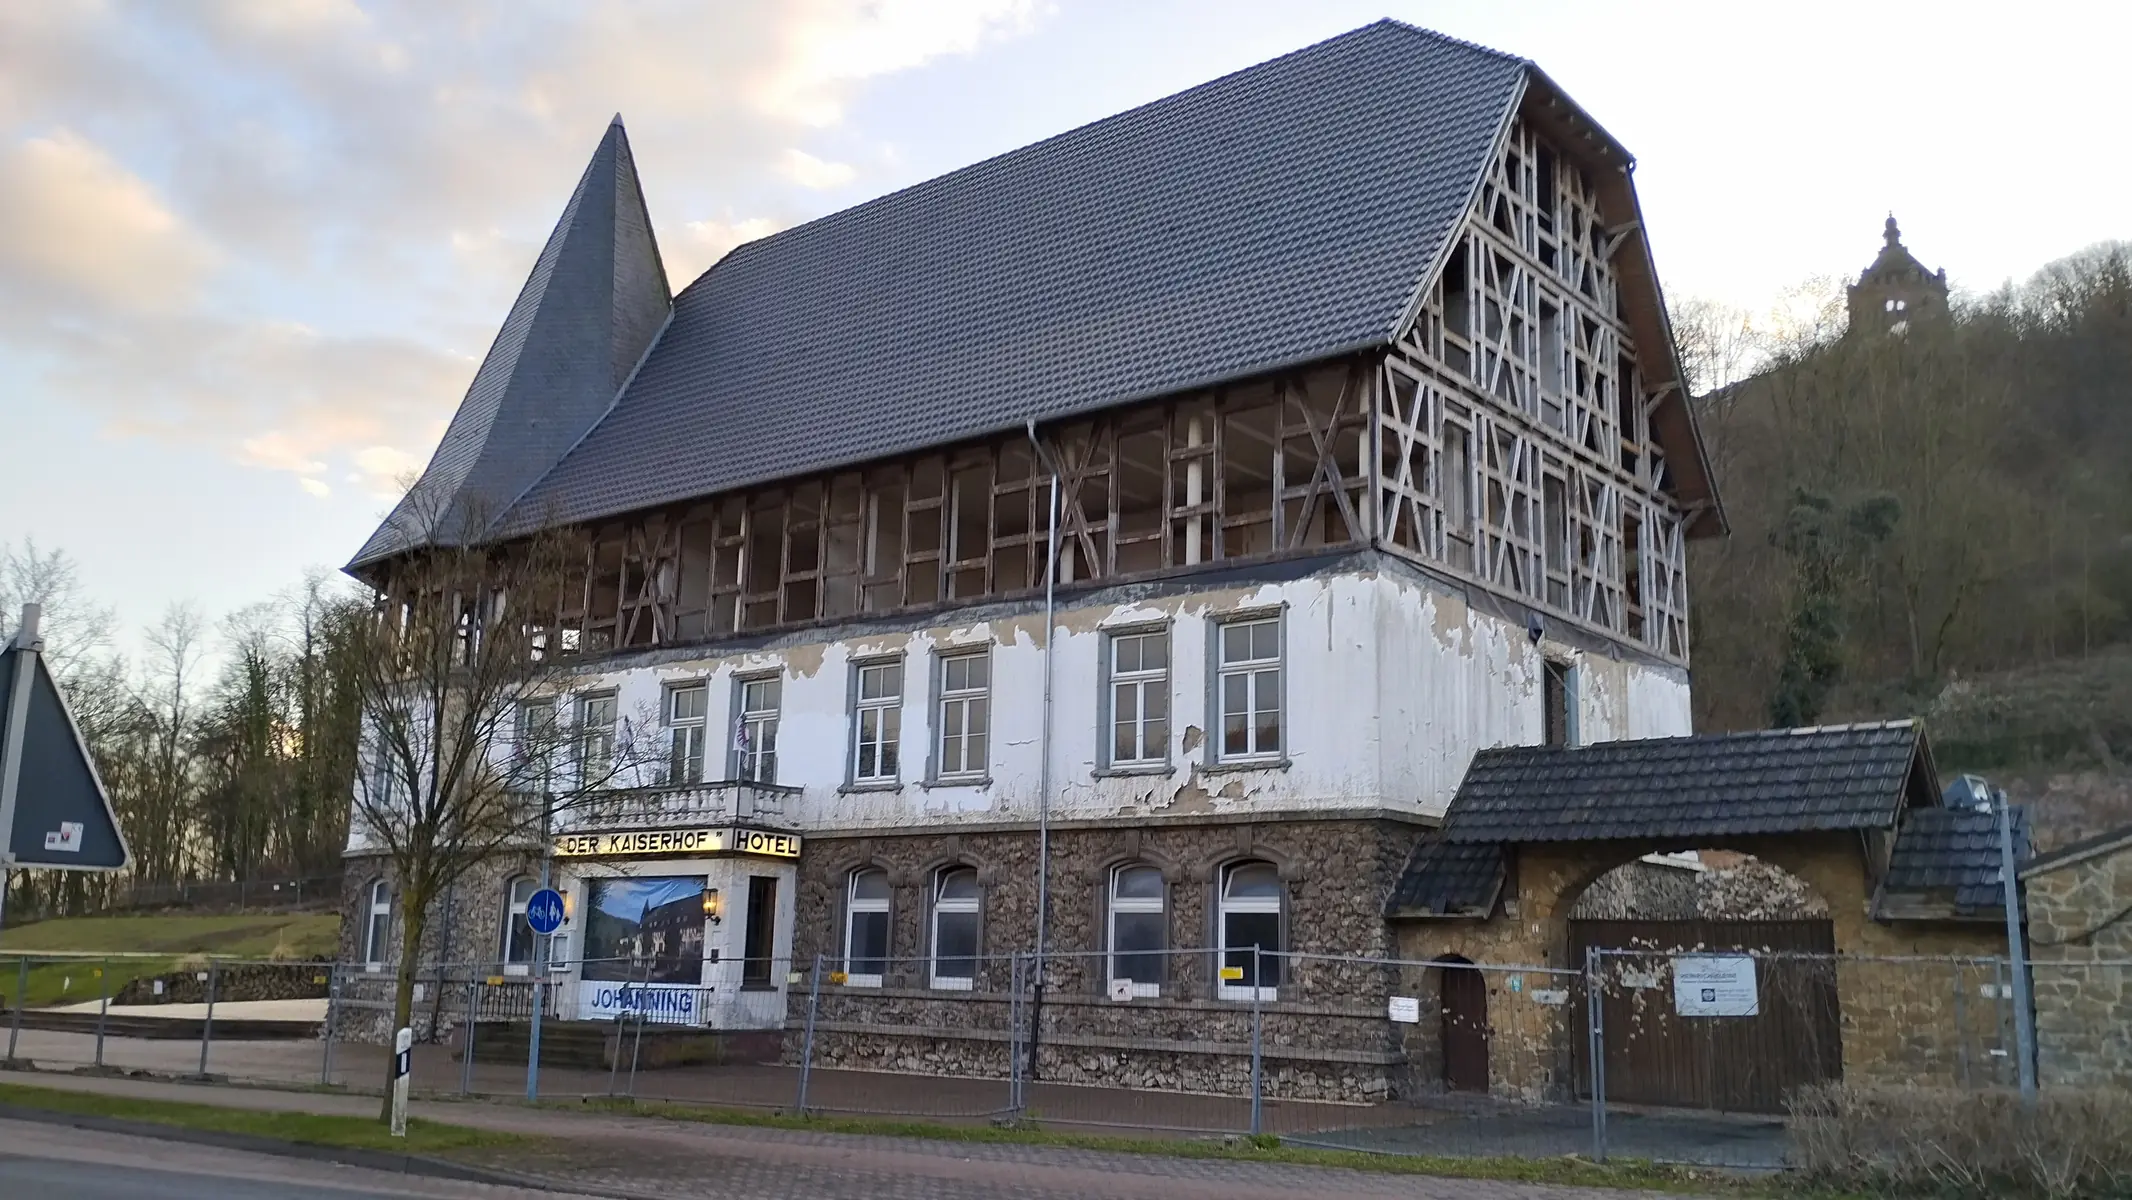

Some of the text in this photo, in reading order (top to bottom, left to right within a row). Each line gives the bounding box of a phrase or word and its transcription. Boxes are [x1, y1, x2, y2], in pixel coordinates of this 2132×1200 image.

[566, 837, 599, 853] DER
[609, 831, 708, 852] KAISERHOF
[735, 830, 798, 855] HOTEL
